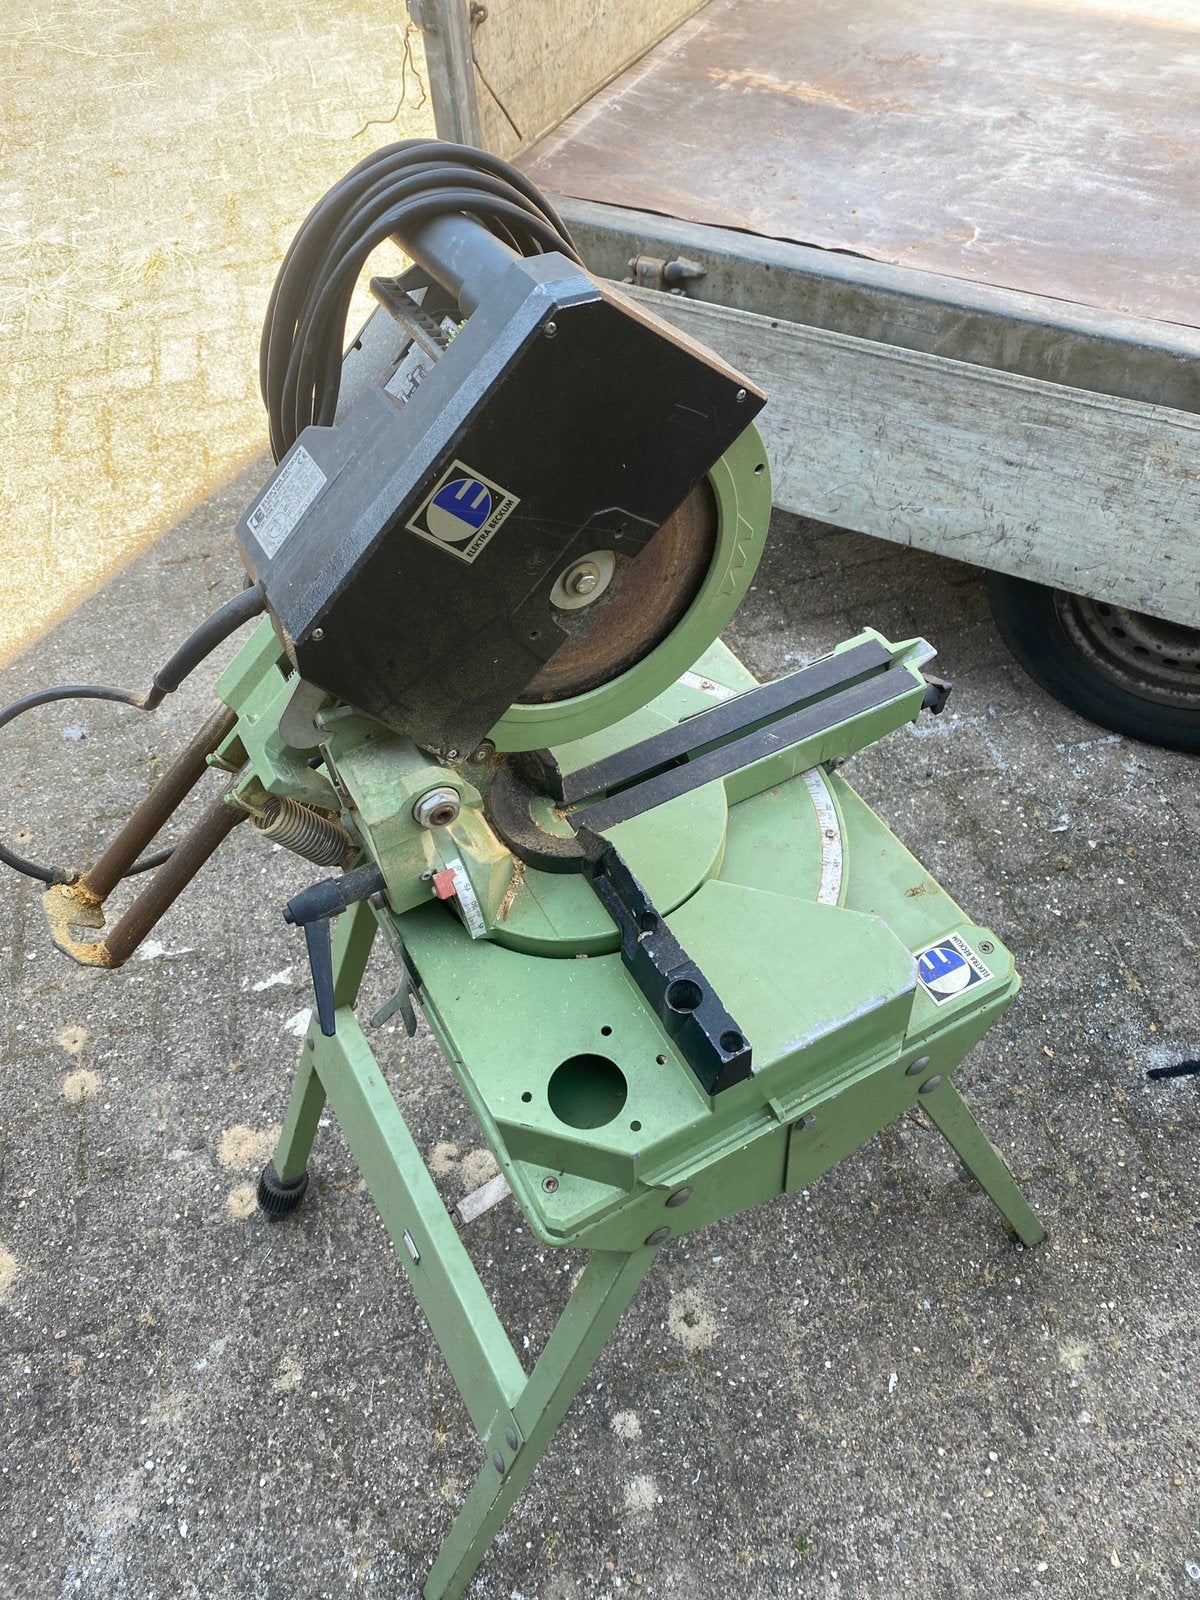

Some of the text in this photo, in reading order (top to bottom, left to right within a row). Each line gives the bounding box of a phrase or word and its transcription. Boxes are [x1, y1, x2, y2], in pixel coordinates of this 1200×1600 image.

[261, 479, 283, 508] ELEKTRA
[281, 449, 303, 480] BECKUM
[466, 499, 515, 558] ELEKTRA BECKUM
[952, 935, 991, 978] ELEKTRA BECKUM
